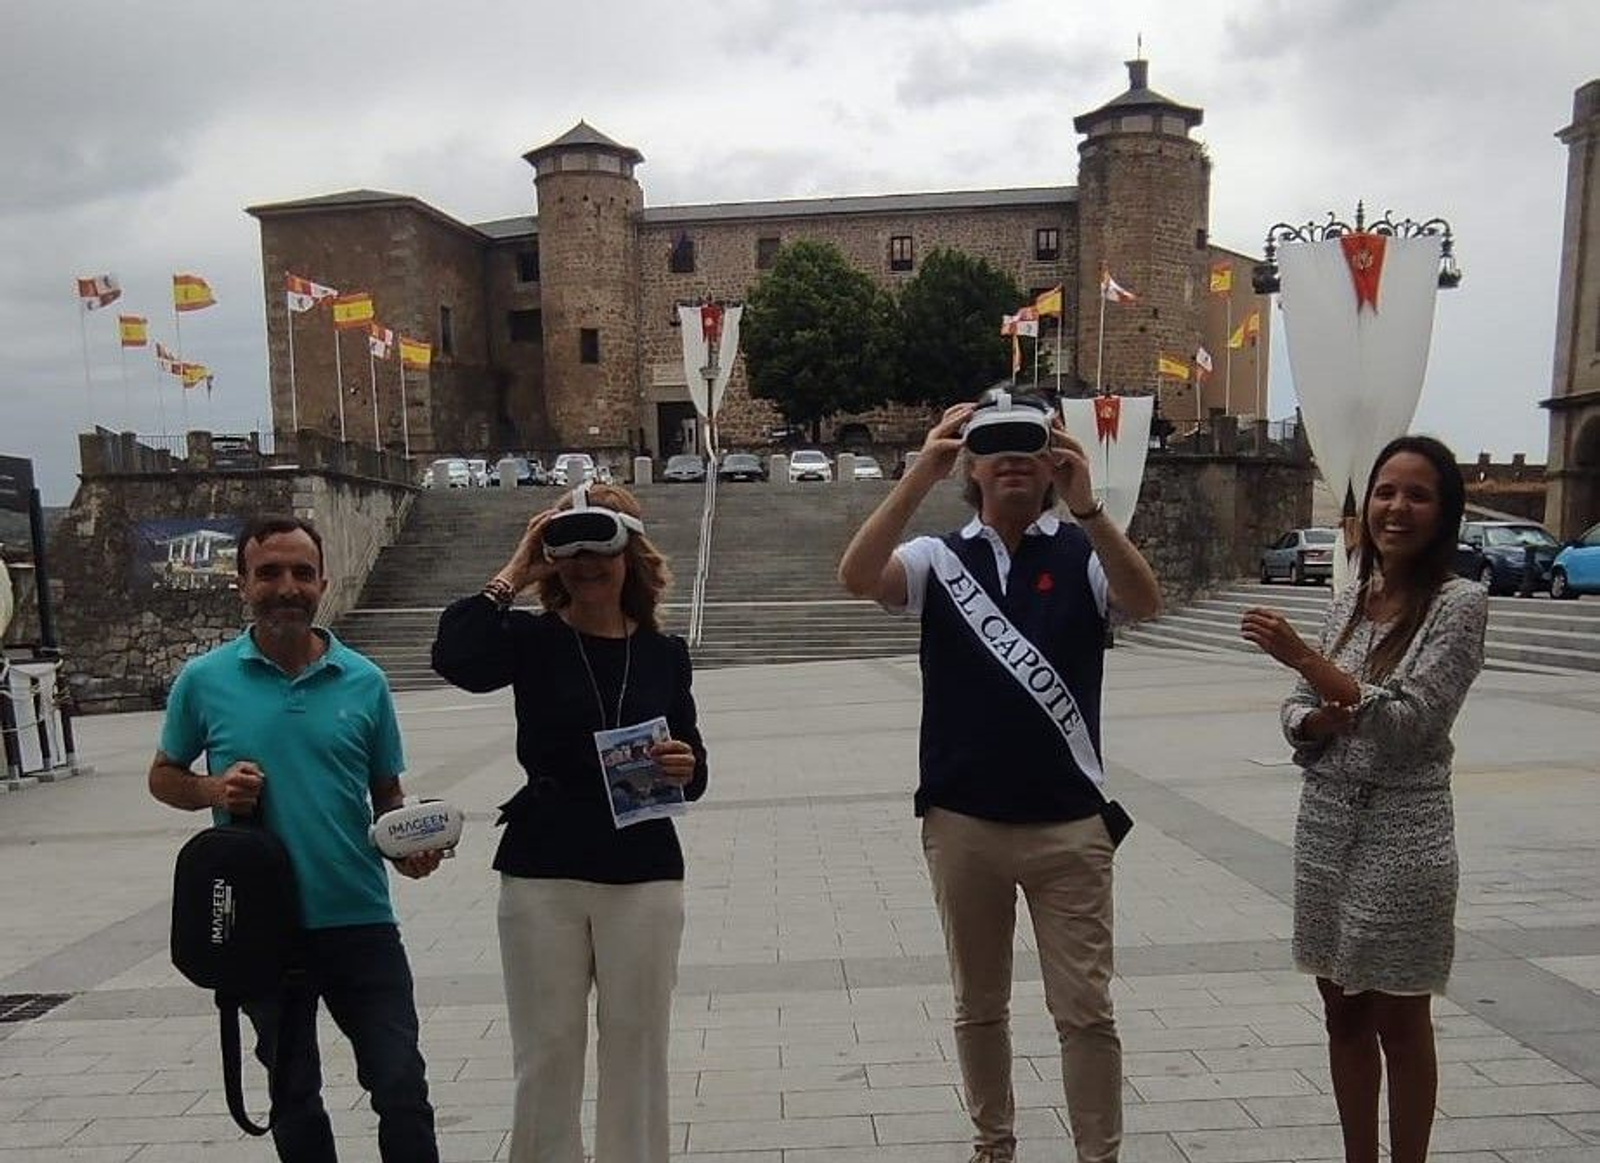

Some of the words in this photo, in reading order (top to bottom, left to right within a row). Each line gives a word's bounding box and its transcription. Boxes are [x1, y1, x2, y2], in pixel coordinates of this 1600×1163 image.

[945, 571, 982, 615] EL
[981, 615, 1080, 735] CAPOTE
[211, 878, 225, 944] IMAGEEN
